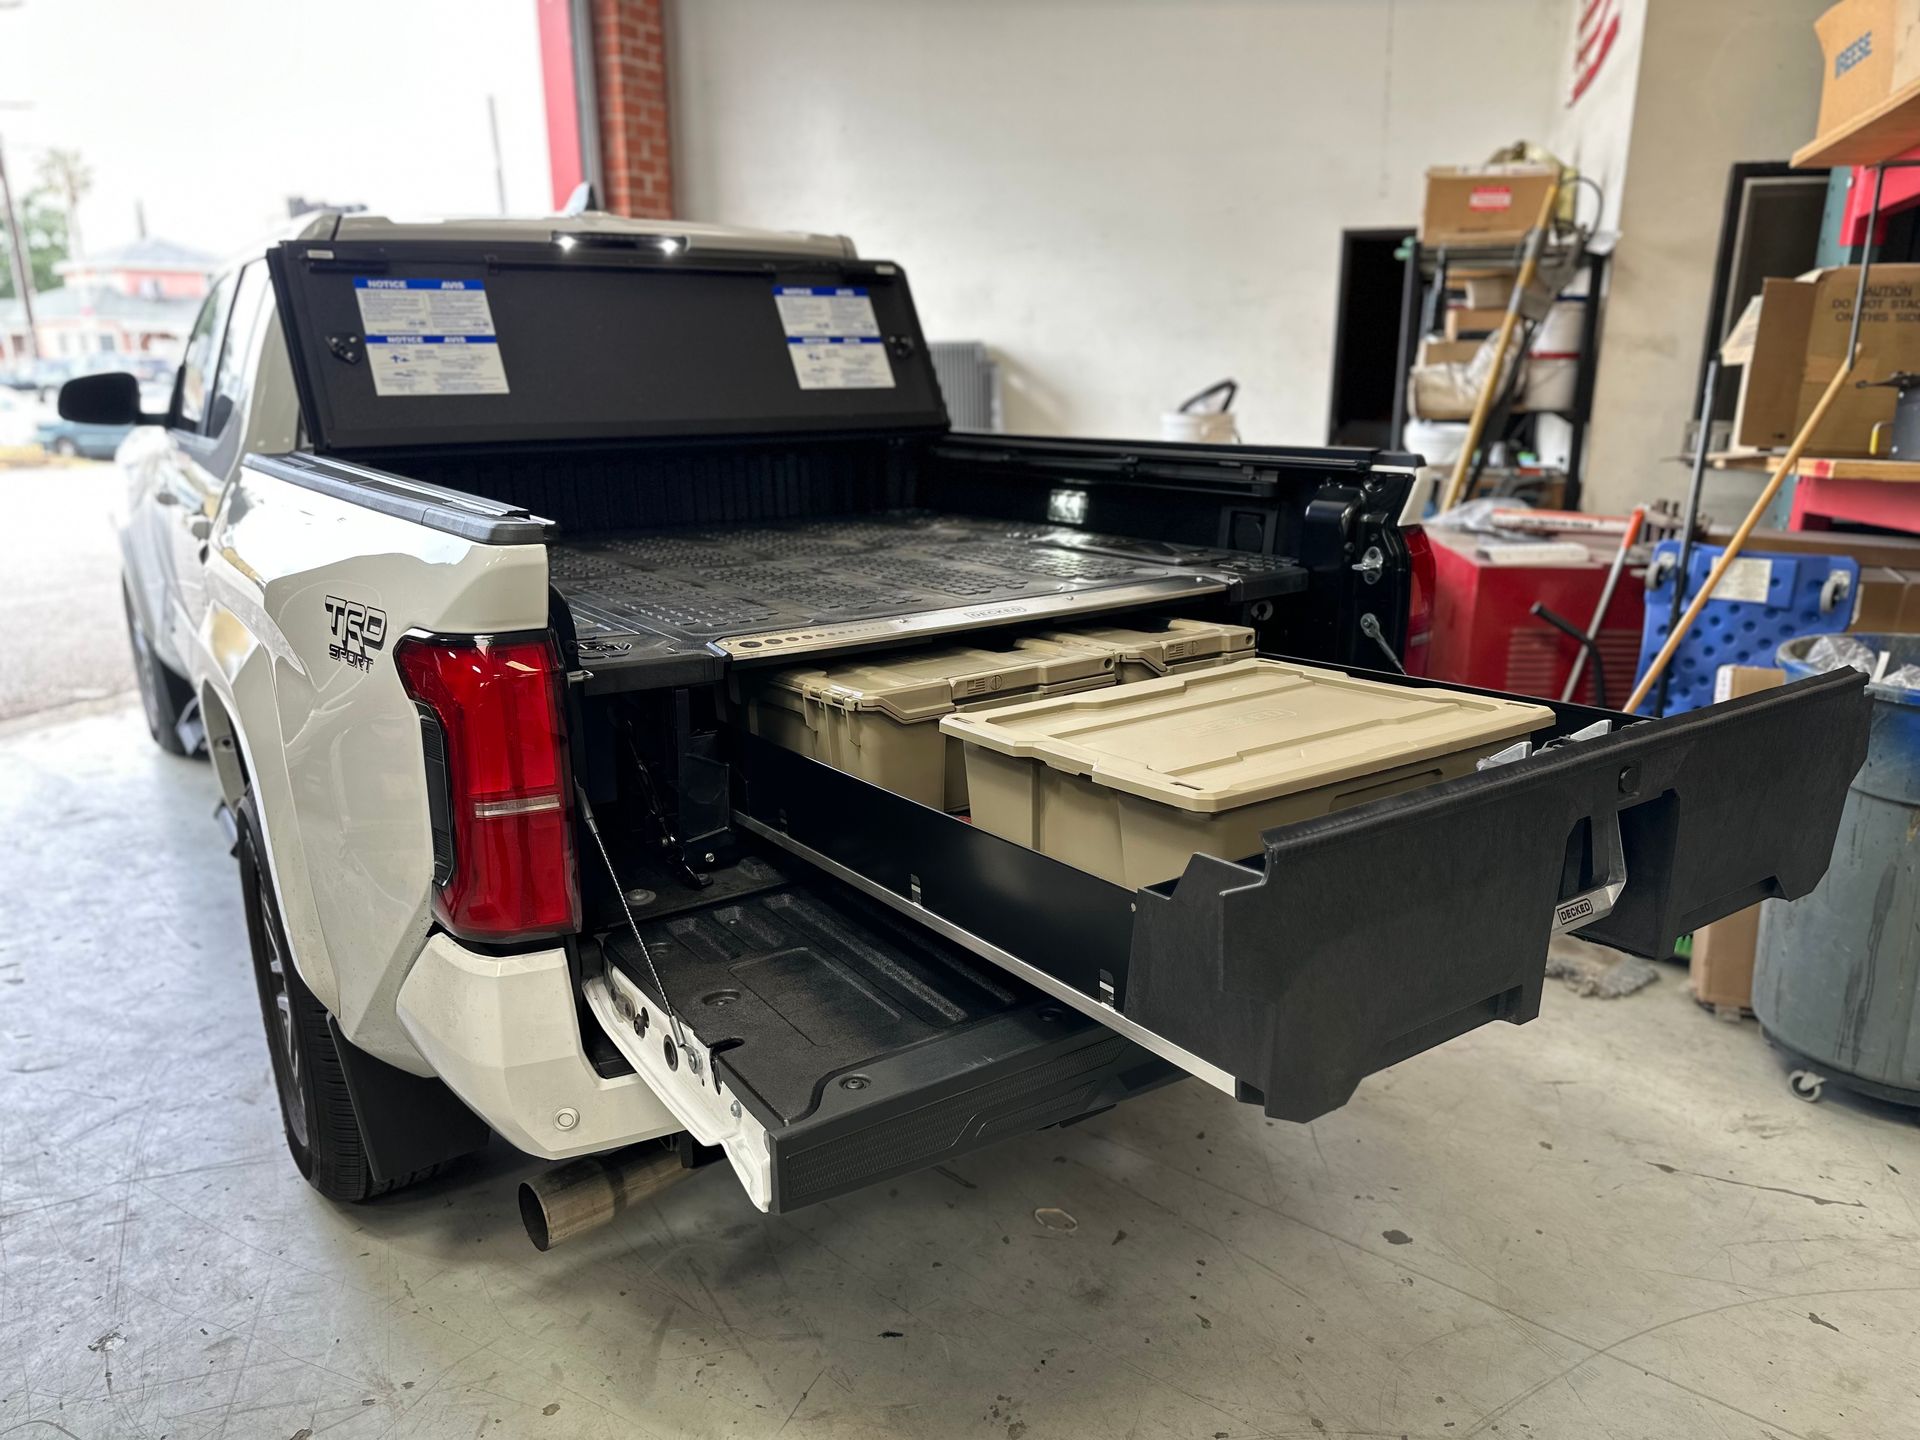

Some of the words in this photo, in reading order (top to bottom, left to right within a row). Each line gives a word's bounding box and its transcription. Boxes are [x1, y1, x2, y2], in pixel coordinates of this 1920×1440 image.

[366, 279, 407, 289] NOTICE
[441, 281, 465, 290] AVIS
[1832, 298, 1851, 309] DO
[387, 336, 424, 344] NOTICE
[443, 336, 466, 344] AVIS
[968, 606, 1021, 618] DECKED
[325, 595, 387, 658] TRD
[329, 643, 374, 673] SPORT
[1560, 902, 1591, 921] DECKED
